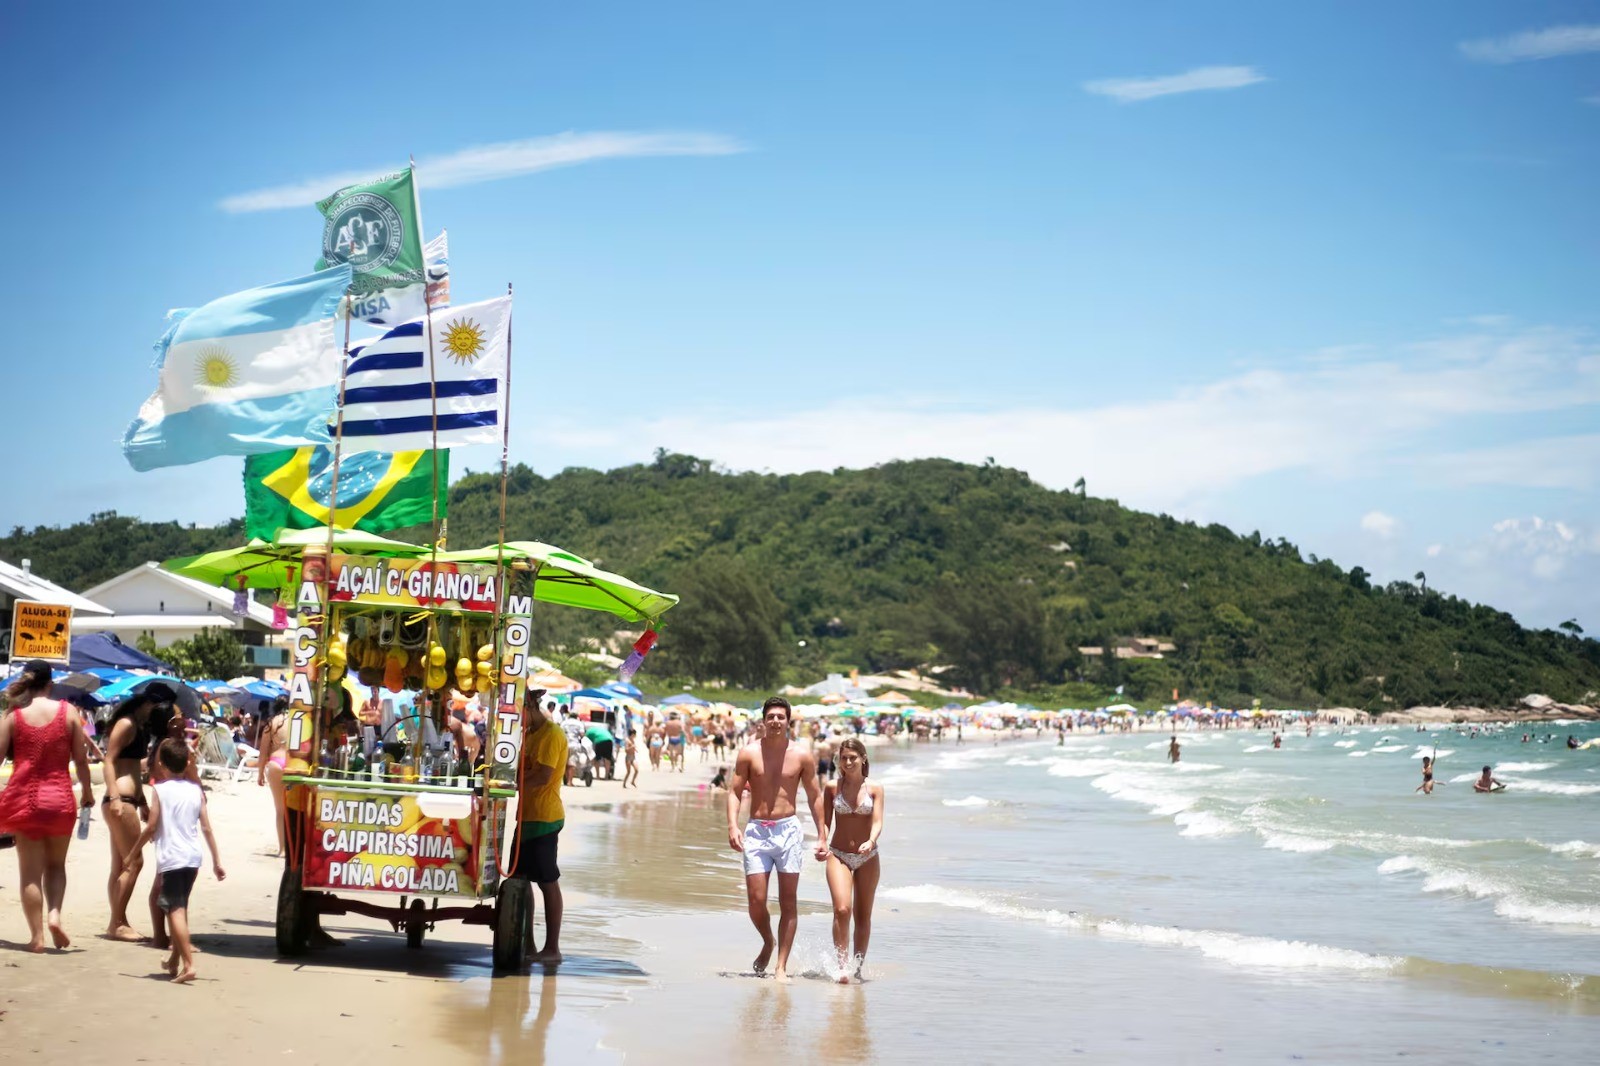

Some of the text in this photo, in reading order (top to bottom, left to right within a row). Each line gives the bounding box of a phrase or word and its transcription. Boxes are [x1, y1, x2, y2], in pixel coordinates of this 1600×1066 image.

[384, 207, 396, 221] DE
[386, 219, 401, 259] FUTEBOL
[350, 296, 391, 318] VISA
[335, 562, 382, 599] AÇAÍ
[408, 570, 496, 603] GRANOLA
[21, 619, 48, 629] CADEIRAS
[22, 607, 67, 618] ALUGA-SE
[28, 645, 52, 653] GUARDA
[289, 581, 321, 750] AÇAÍ
[494, 595, 533, 765] MOJITO
[320, 799, 403, 826] BATIDAS
[322, 829, 455, 859] CAIPIRISSIMA
[329, 859, 459, 893] PIÑA COLADA
